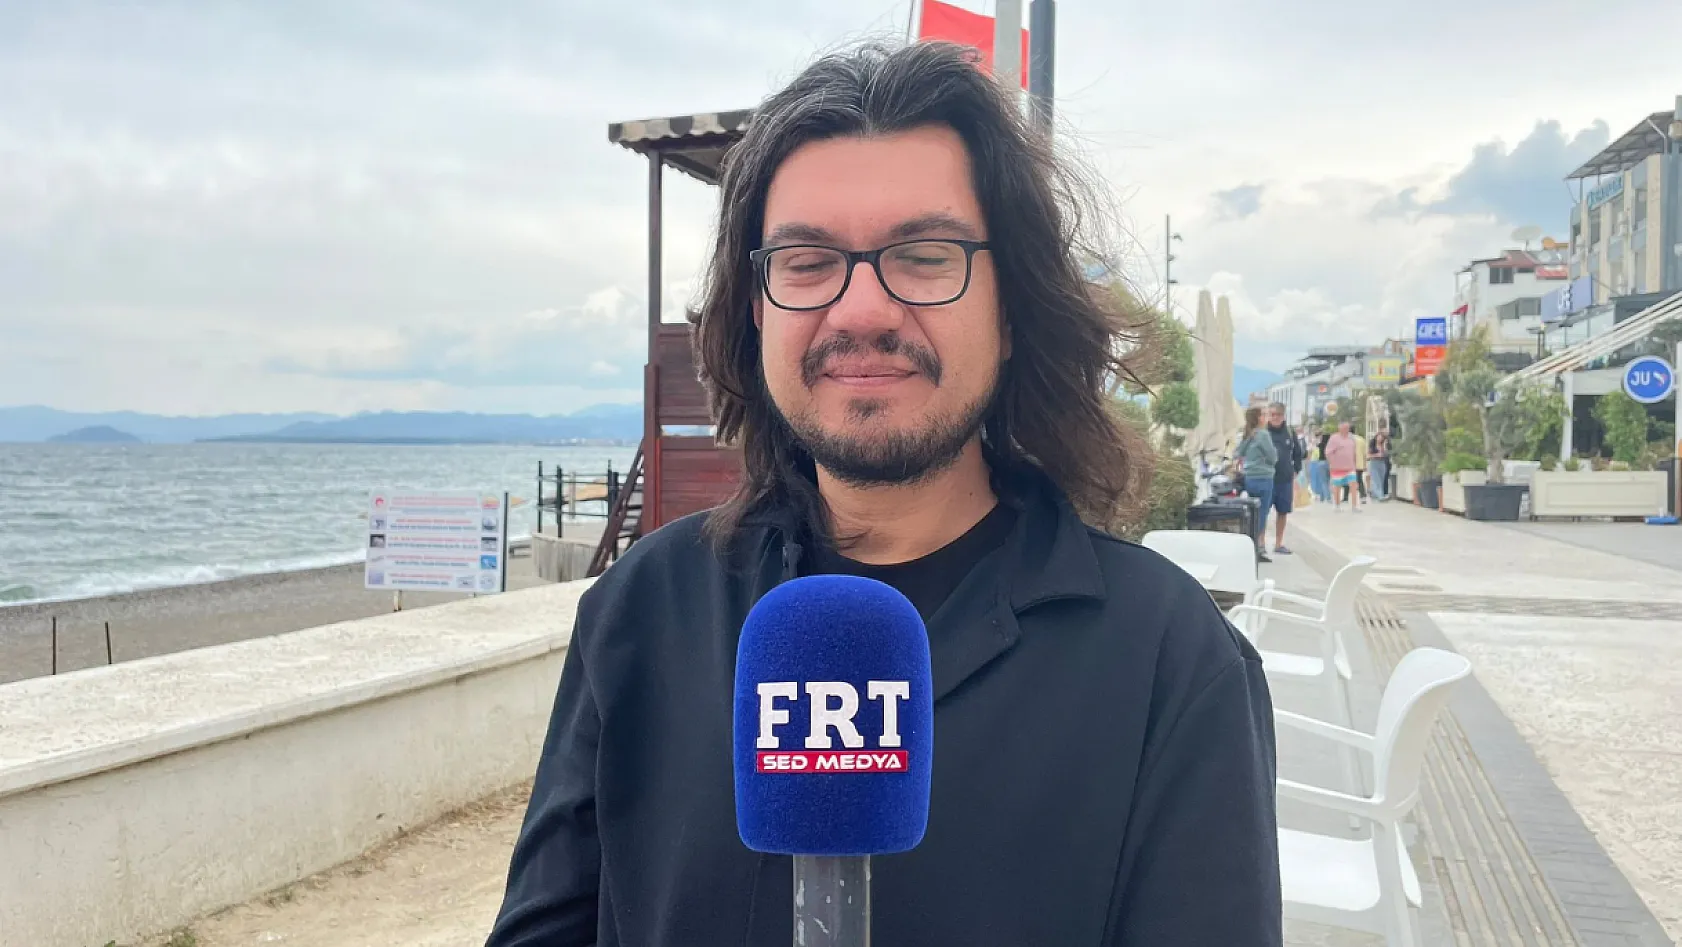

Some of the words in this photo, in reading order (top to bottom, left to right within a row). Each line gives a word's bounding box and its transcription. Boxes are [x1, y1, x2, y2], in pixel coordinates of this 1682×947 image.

[756, 681, 910, 749] FRT
[763, 755, 809, 770] SED
[815, 754, 902, 770] MEDYA
